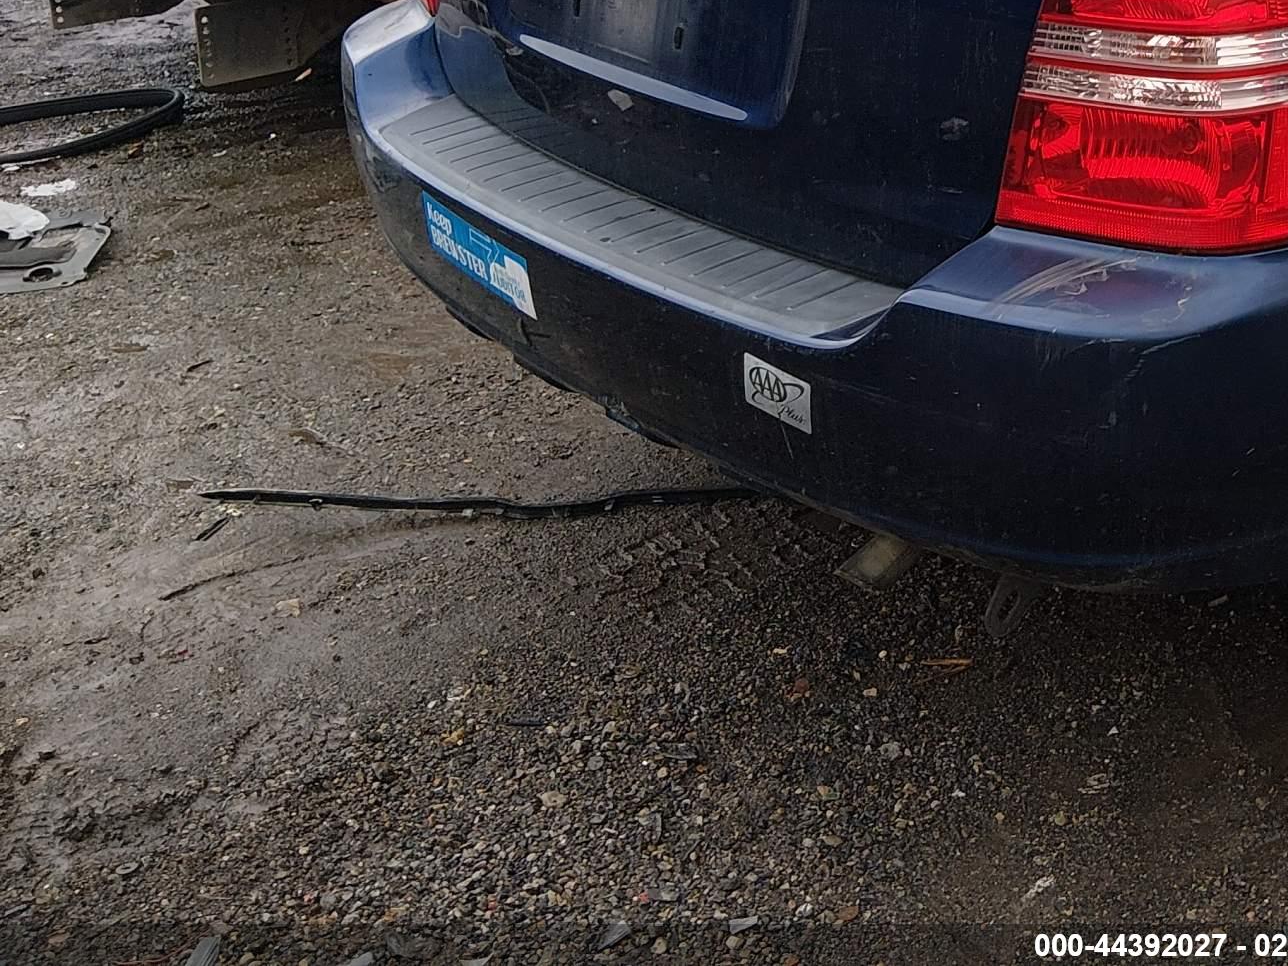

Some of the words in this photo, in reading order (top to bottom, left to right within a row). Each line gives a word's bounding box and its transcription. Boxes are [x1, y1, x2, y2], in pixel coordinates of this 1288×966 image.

[426, 201, 453, 237] Keep
[430, 224, 489, 282] BREWSTER
[752, 366, 785, 402] AAA
